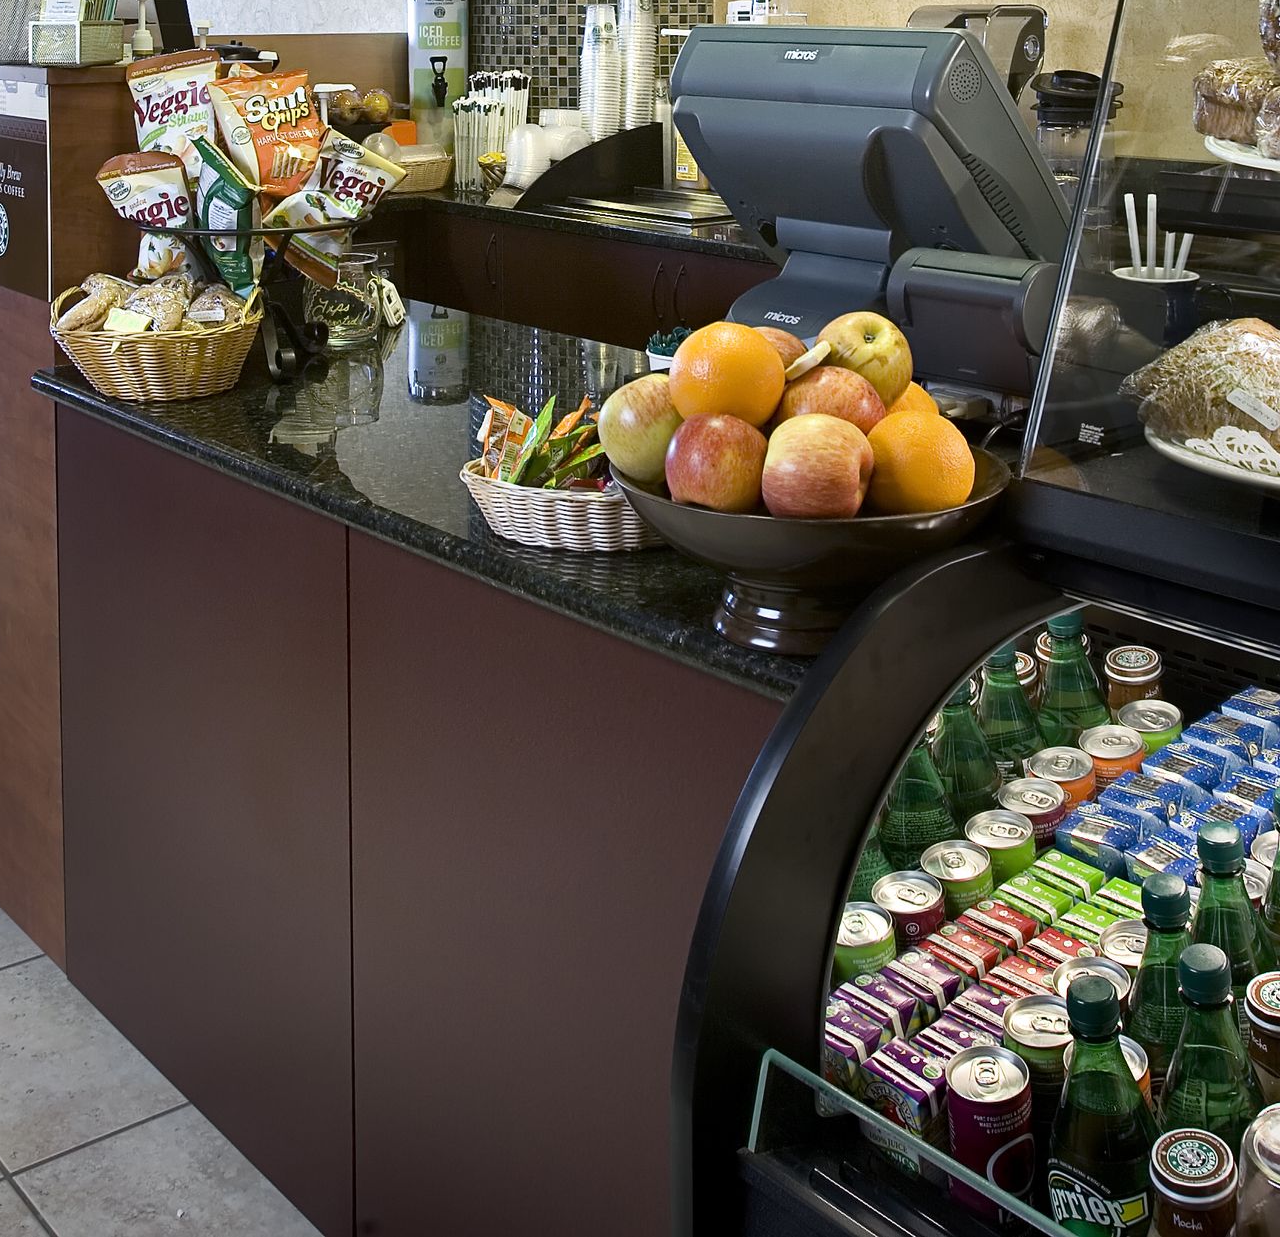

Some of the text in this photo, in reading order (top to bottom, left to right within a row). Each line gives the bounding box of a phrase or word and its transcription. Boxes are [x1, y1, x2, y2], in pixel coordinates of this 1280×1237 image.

[420, 26, 442, 38] ICED
[427, 36, 460, 46] COFFEE
[784, 48, 818, 61] micros
[131, 81, 211, 127] Veggie
[244, 86, 307, 123] Sun
[256, 131, 287, 146] HARVEST
[8, 165, 21, 181] Brew
[4, 184, 24, 197] COFFEE
[764, 310, 802, 324] micros
[1173, 1214, 1203, 1231] Mocha
